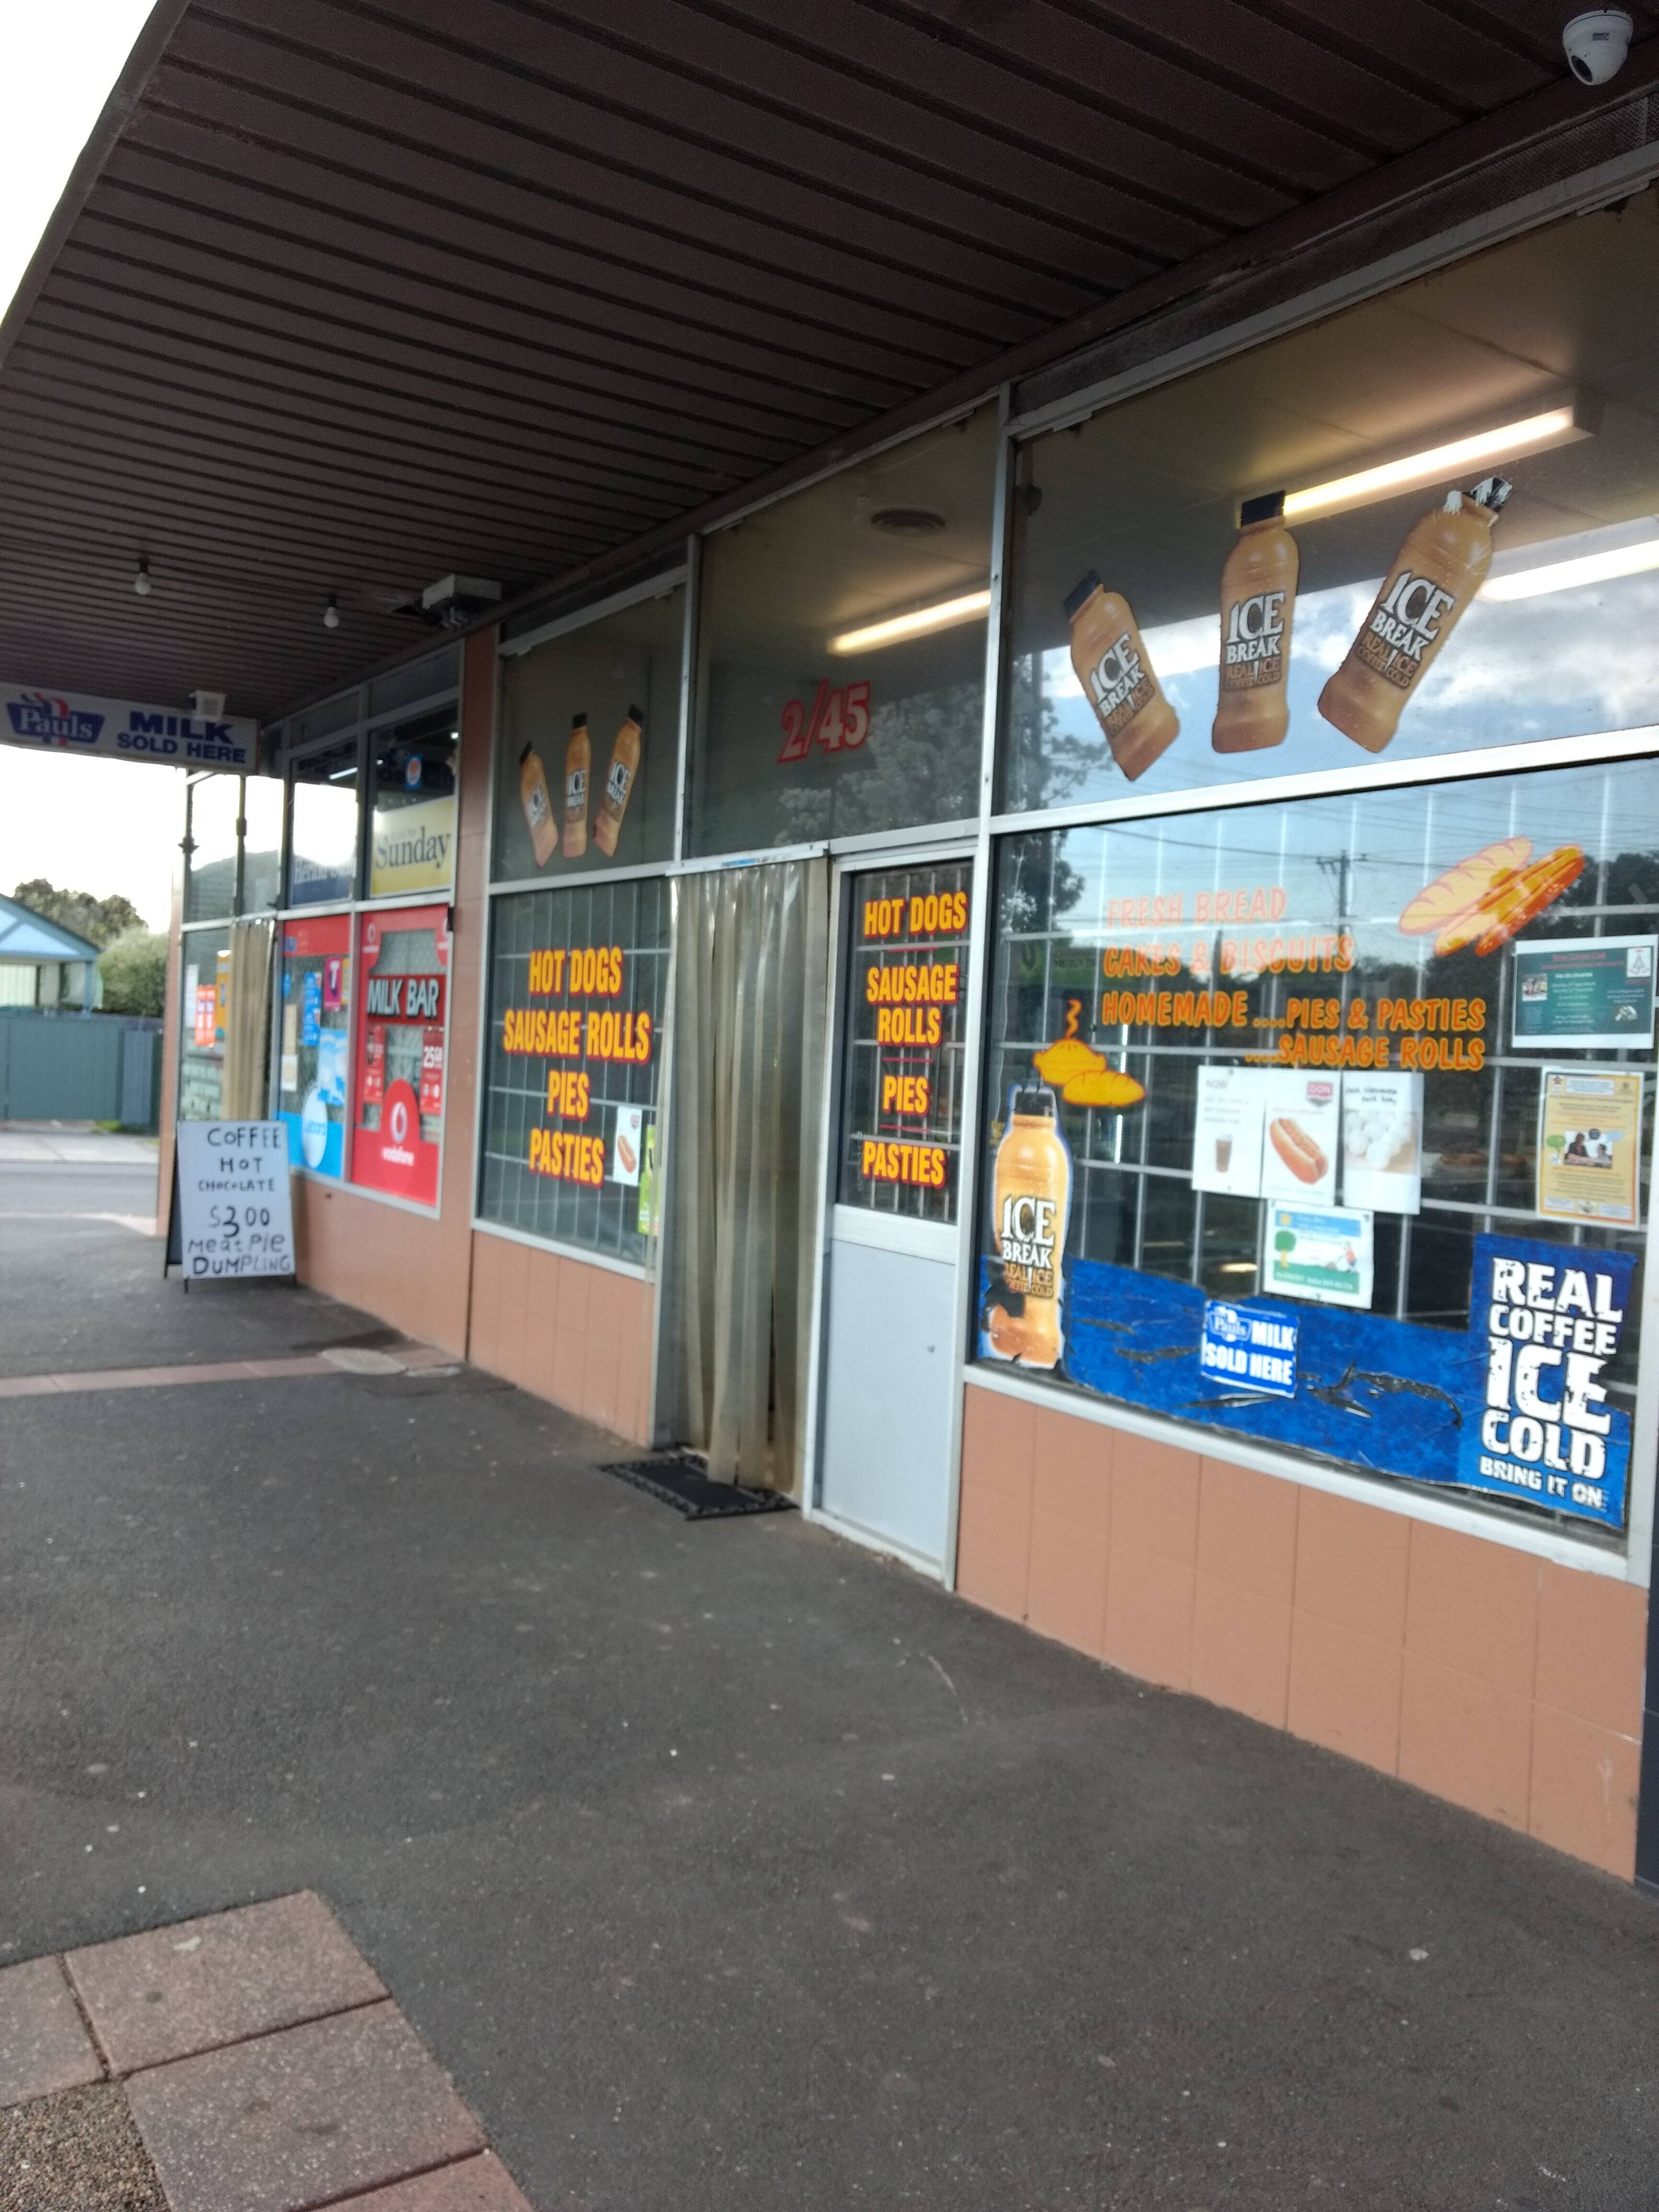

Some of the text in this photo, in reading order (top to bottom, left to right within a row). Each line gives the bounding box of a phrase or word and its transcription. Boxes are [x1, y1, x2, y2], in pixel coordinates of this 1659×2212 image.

[1226, 592, 1285, 643] ICE
[1380, 571, 1455, 640] ICE
[1226, 635, 1280, 664] BREAK
[1370, 611, 1430, 661] BREAK
[1091, 633, 1140, 700] ICE
[1100, 663, 1145, 718] BREAK
[20, 708, 93, 739] Pauls
[130, 711, 234, 744] MILK
[776, 679, 871, 764] 2/45
[117, 733, 246, 763] SOLD HERE
[375, 826, 451, 870] Sunday
[864, 892, 968, 938] HOT DOGS
[1107, 887, 1287, 929] FRESH BREAD
[529, 946, 623, 998] HOT DOGS
[1104, 943, 1181, 978] CAKES
[1220, 935, 1356, 974] BISCUITS
[367, 977, 440, 1019] MILK BAR
[866, 964, 958, 1006] SAUSAGE
[877, 1008, 942, 1047] ROLLS
[1102, 991, 1248, 1027] HOMEMADE
[1347, 998, 1369, 1030] &
[1377, 998, 1486, 1032] PASTIES
[503, 1009, 652, 1064] SAUSAGE ROLLS
[1400, 1036, 1485, 1071] ROLLS
[547, 1069, 590, 1121] PIES
[882, 1074, 929, 1115] PIES
[220, 1156, 263, 1172] HOT
[529, 1128, 605, 1189] PASTIES
[863, 1141, 947, 1189] PASTIES
[1001, 1196, 1055, 1245] ICE
[1002, 1240, 1052, 1269] BREAK
[1492, 1257, 1623, 1322] REAL
[1251, 1321, 1295, 1352] MILK
[1489, 1304, 1616, 1355] COFFEE
[1205, 1343, 1293, 1385] SOLD HERE
[1487, 1335, 1611, 1435] ICE
[1482, 1409, 1606, 1480] COLD
[1479, 1455, 1542, 1491] BRING
[1546, 1474, 1568, 1497] IT
[1571, 1482, 1603, 1509] ON
